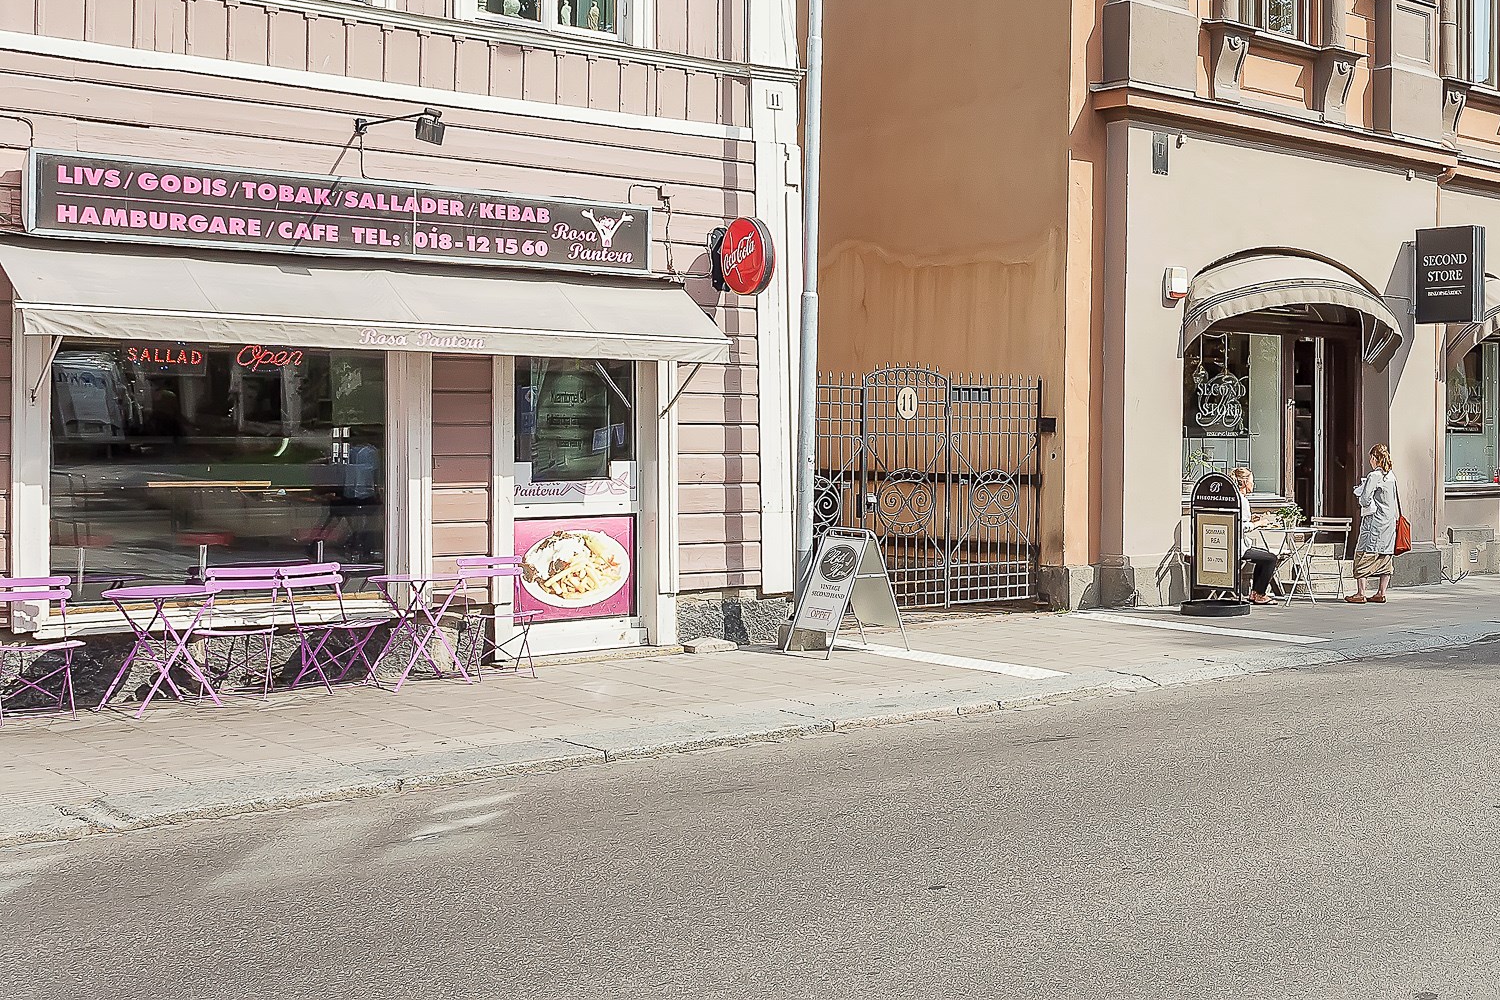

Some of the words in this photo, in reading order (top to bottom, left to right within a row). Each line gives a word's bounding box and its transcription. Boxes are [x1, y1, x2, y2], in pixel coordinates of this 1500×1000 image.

[551, 222, 598, 243] Rosa
[568, 243, 634, 264] Pantern
[1423, 253, 1468, 267] SECOND
[1427, 269, 1463, 282] STORE
[359, 328, 408, 346] Rosa
[416, 330, 486, 349] Pantern
[127, 347, 202, 365] SALLAD
[236, 345, 304, 372] Open
[902, 393, 913, 412] 11
